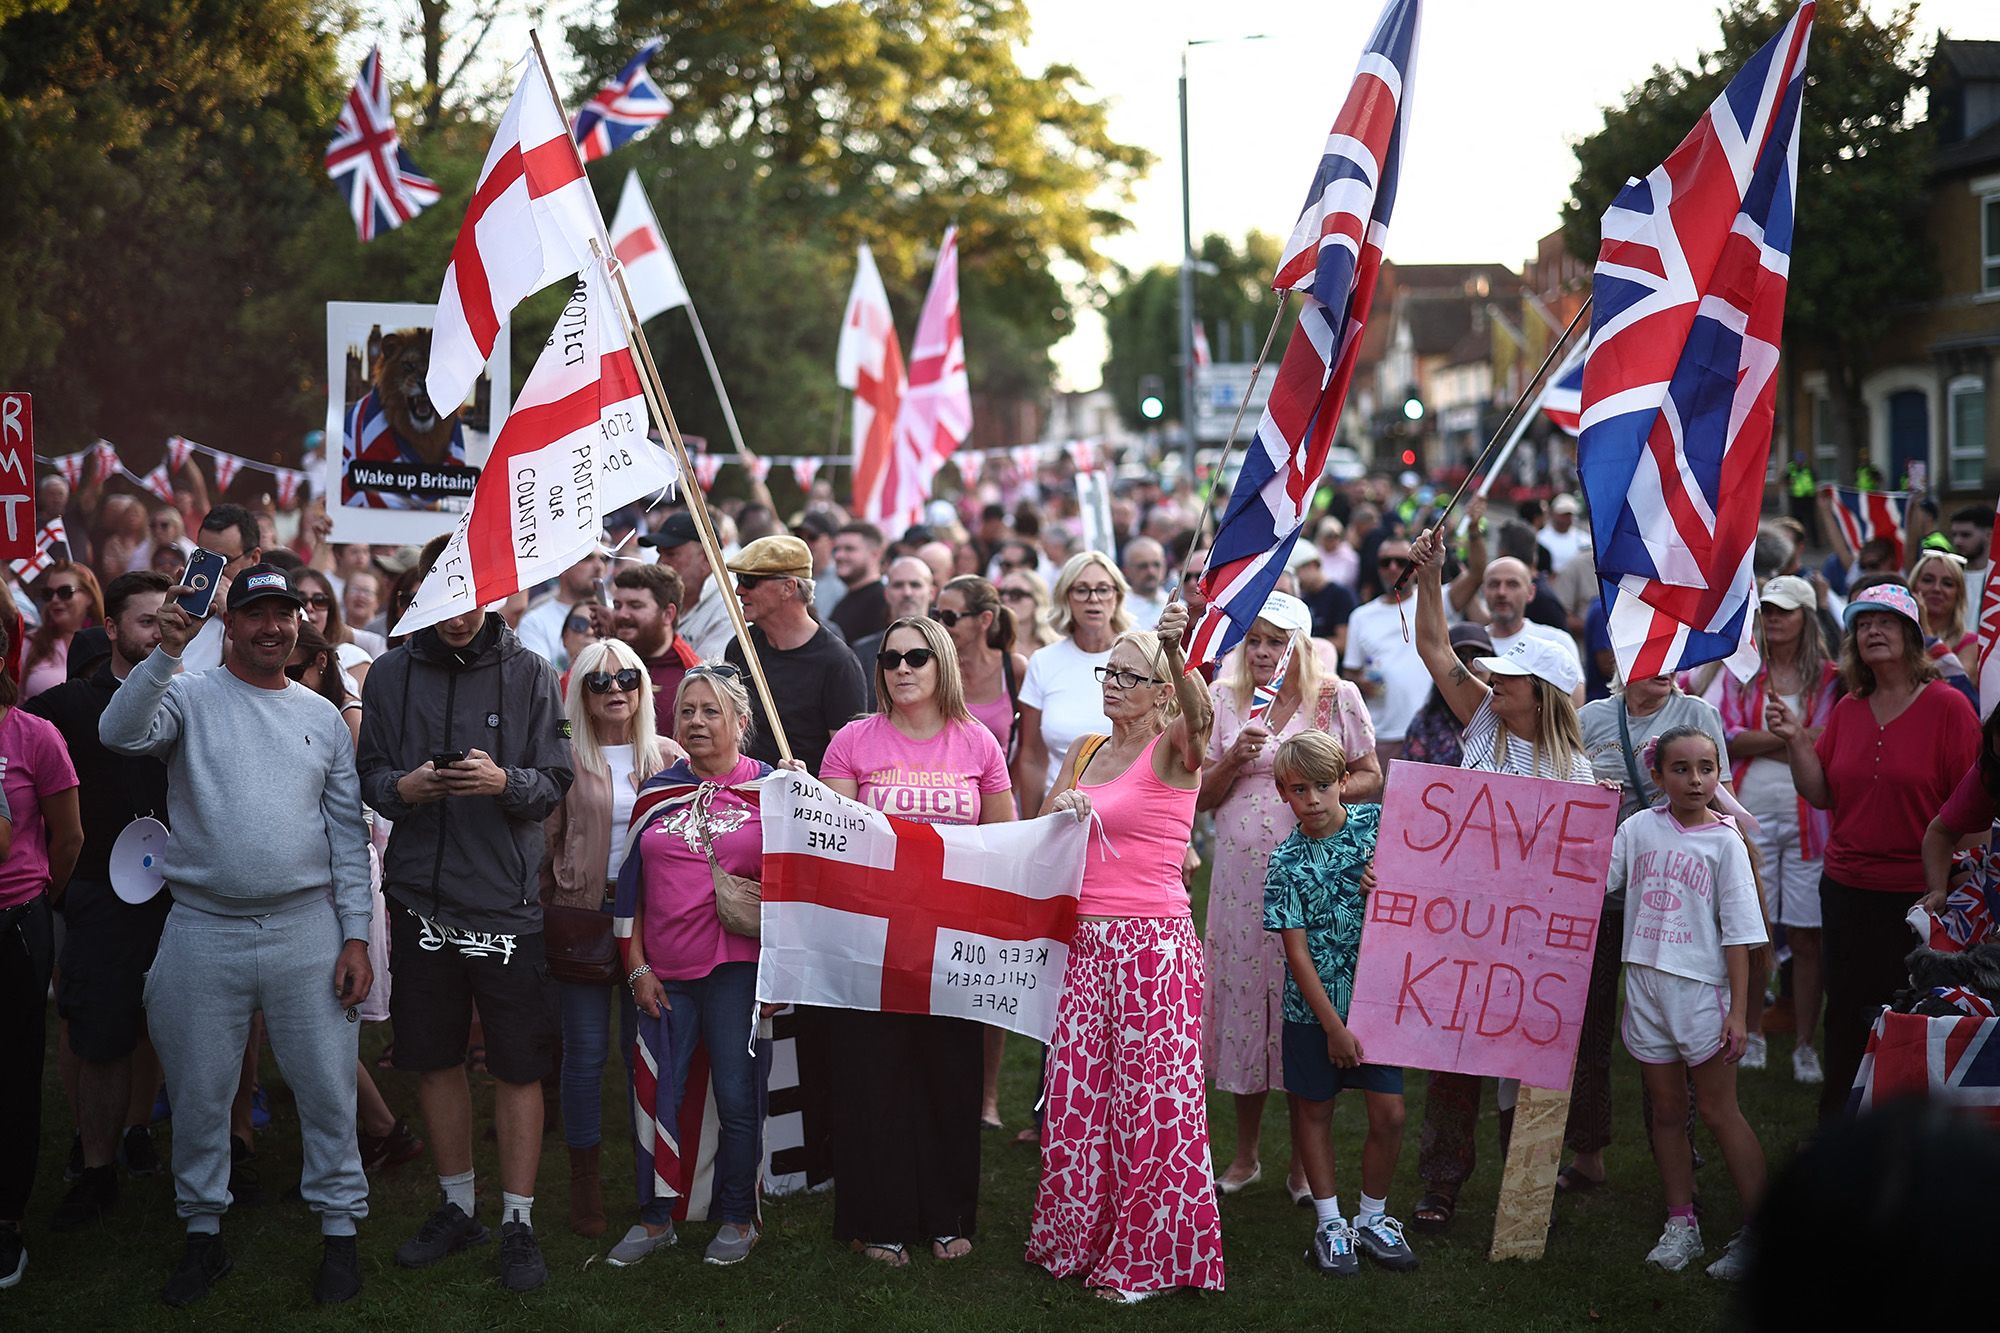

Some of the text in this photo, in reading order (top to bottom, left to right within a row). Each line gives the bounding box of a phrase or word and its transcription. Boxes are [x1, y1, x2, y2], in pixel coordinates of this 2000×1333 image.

[354, 469, 476, 491] Wake up Britain!
[572, 445, 595, 530] PROTECT
[516, 468, 539, 559] COUNTRY
[549, 485, 565, 521] OUR
[869, 768, 969, 788] CHILDREN'S
[874, 787, 971, 816] VOICE
[1403, 782, 1611, 883] SAVE
[1661, 928, 1693, 944] TEAM
[1395, 951, 1567, 1046] KIDS
